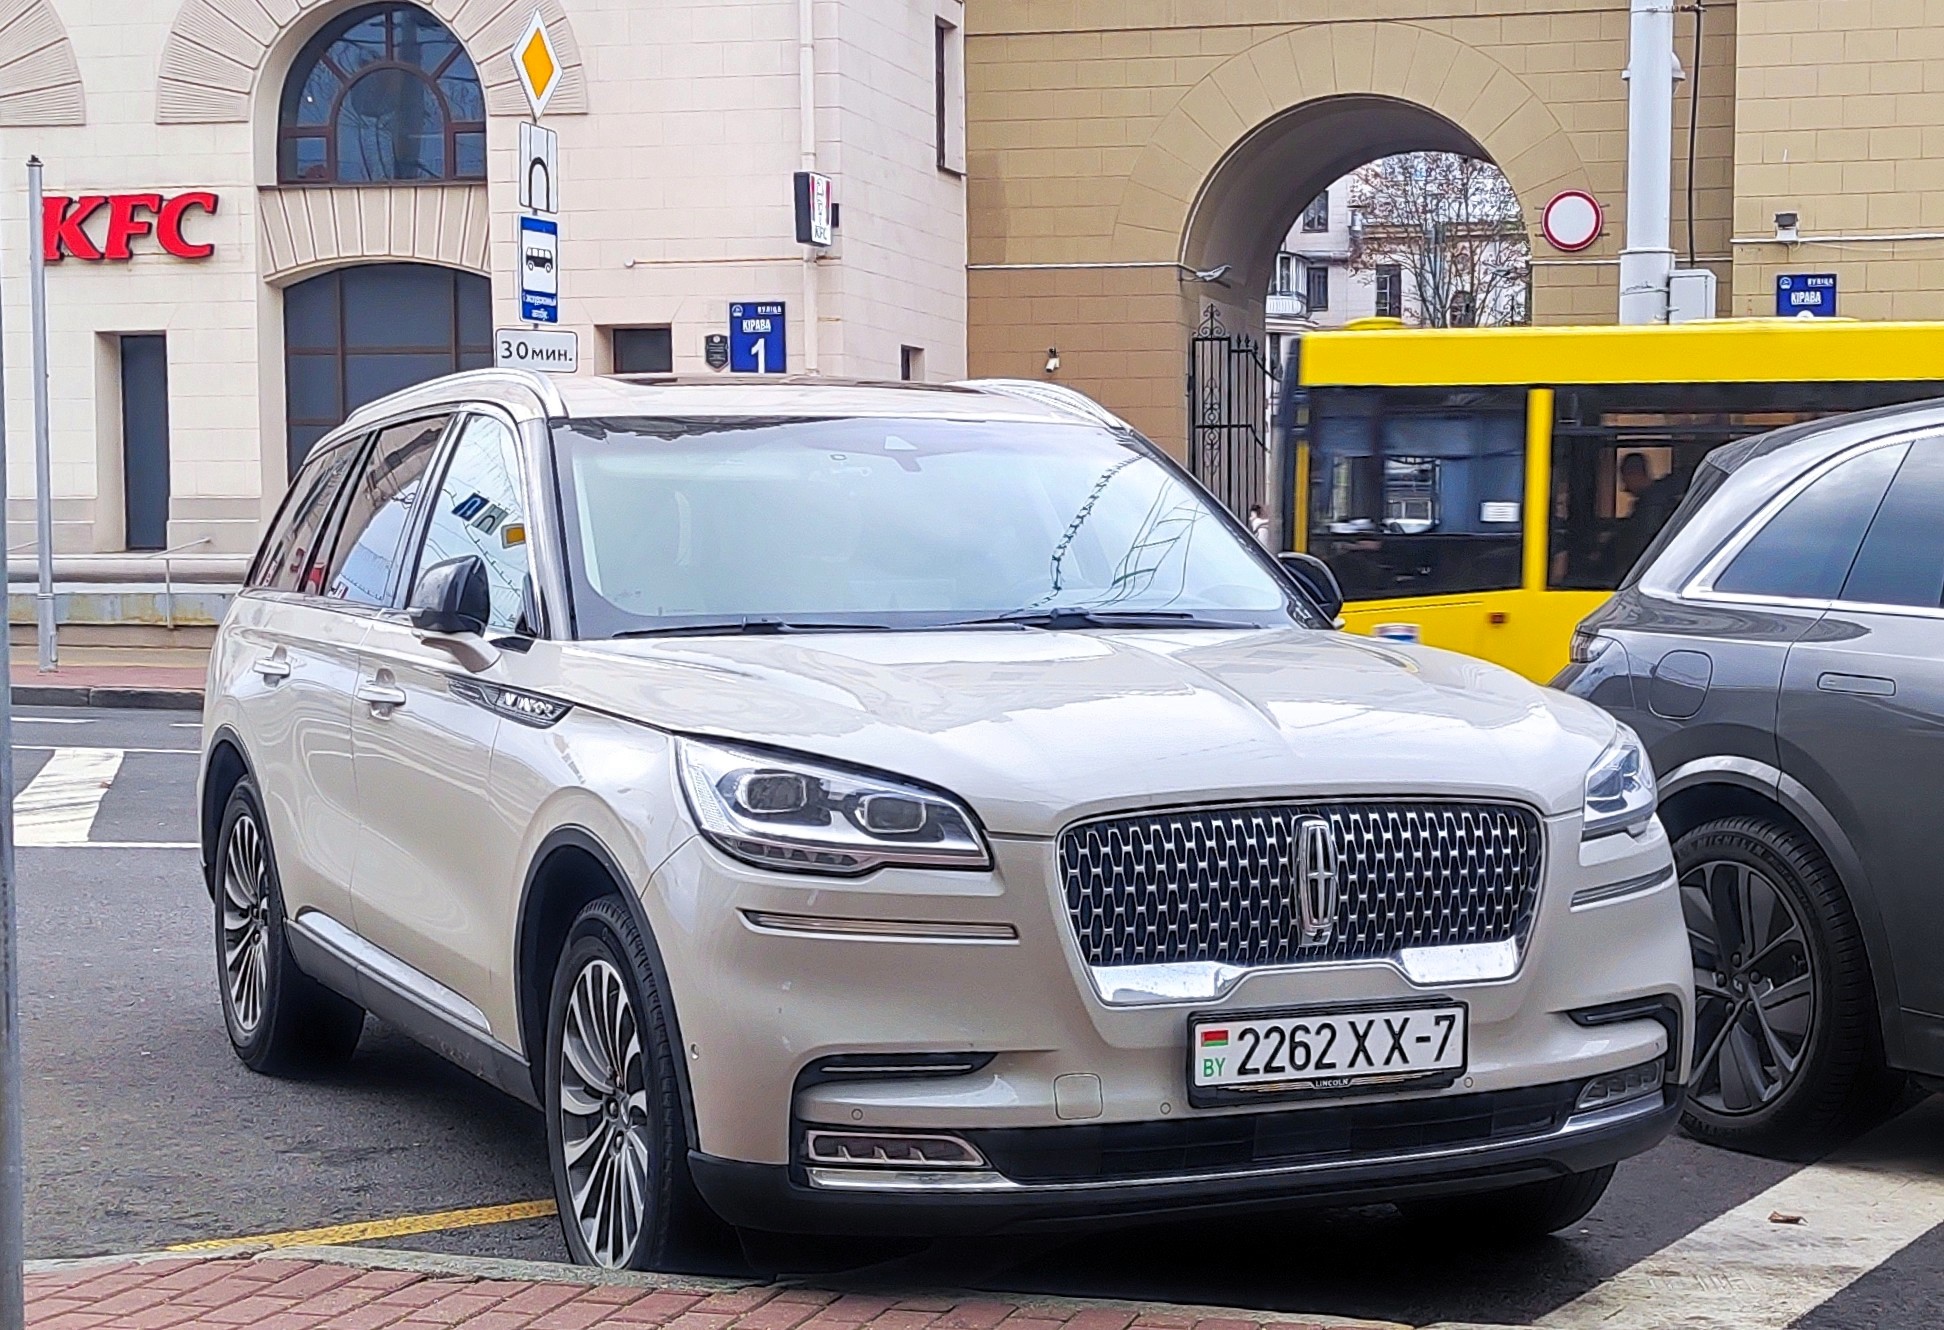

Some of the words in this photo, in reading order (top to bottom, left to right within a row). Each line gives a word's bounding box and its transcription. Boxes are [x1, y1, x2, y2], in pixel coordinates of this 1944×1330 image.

[42, 192, 218, 260] KFC
[742, 319, 772, 332] КІРАВА
[751, 338, 765, 374] 1
[1697, 835, 1766, 857] MICHELIN
[1237, 1022, 1337, 1076] 2262
[1347, 1014, 1456, 1068] XX-7
[1203, 1057, 1226, 1078] BY
[1315, 1078, 1349, 1087] LINCOLN
